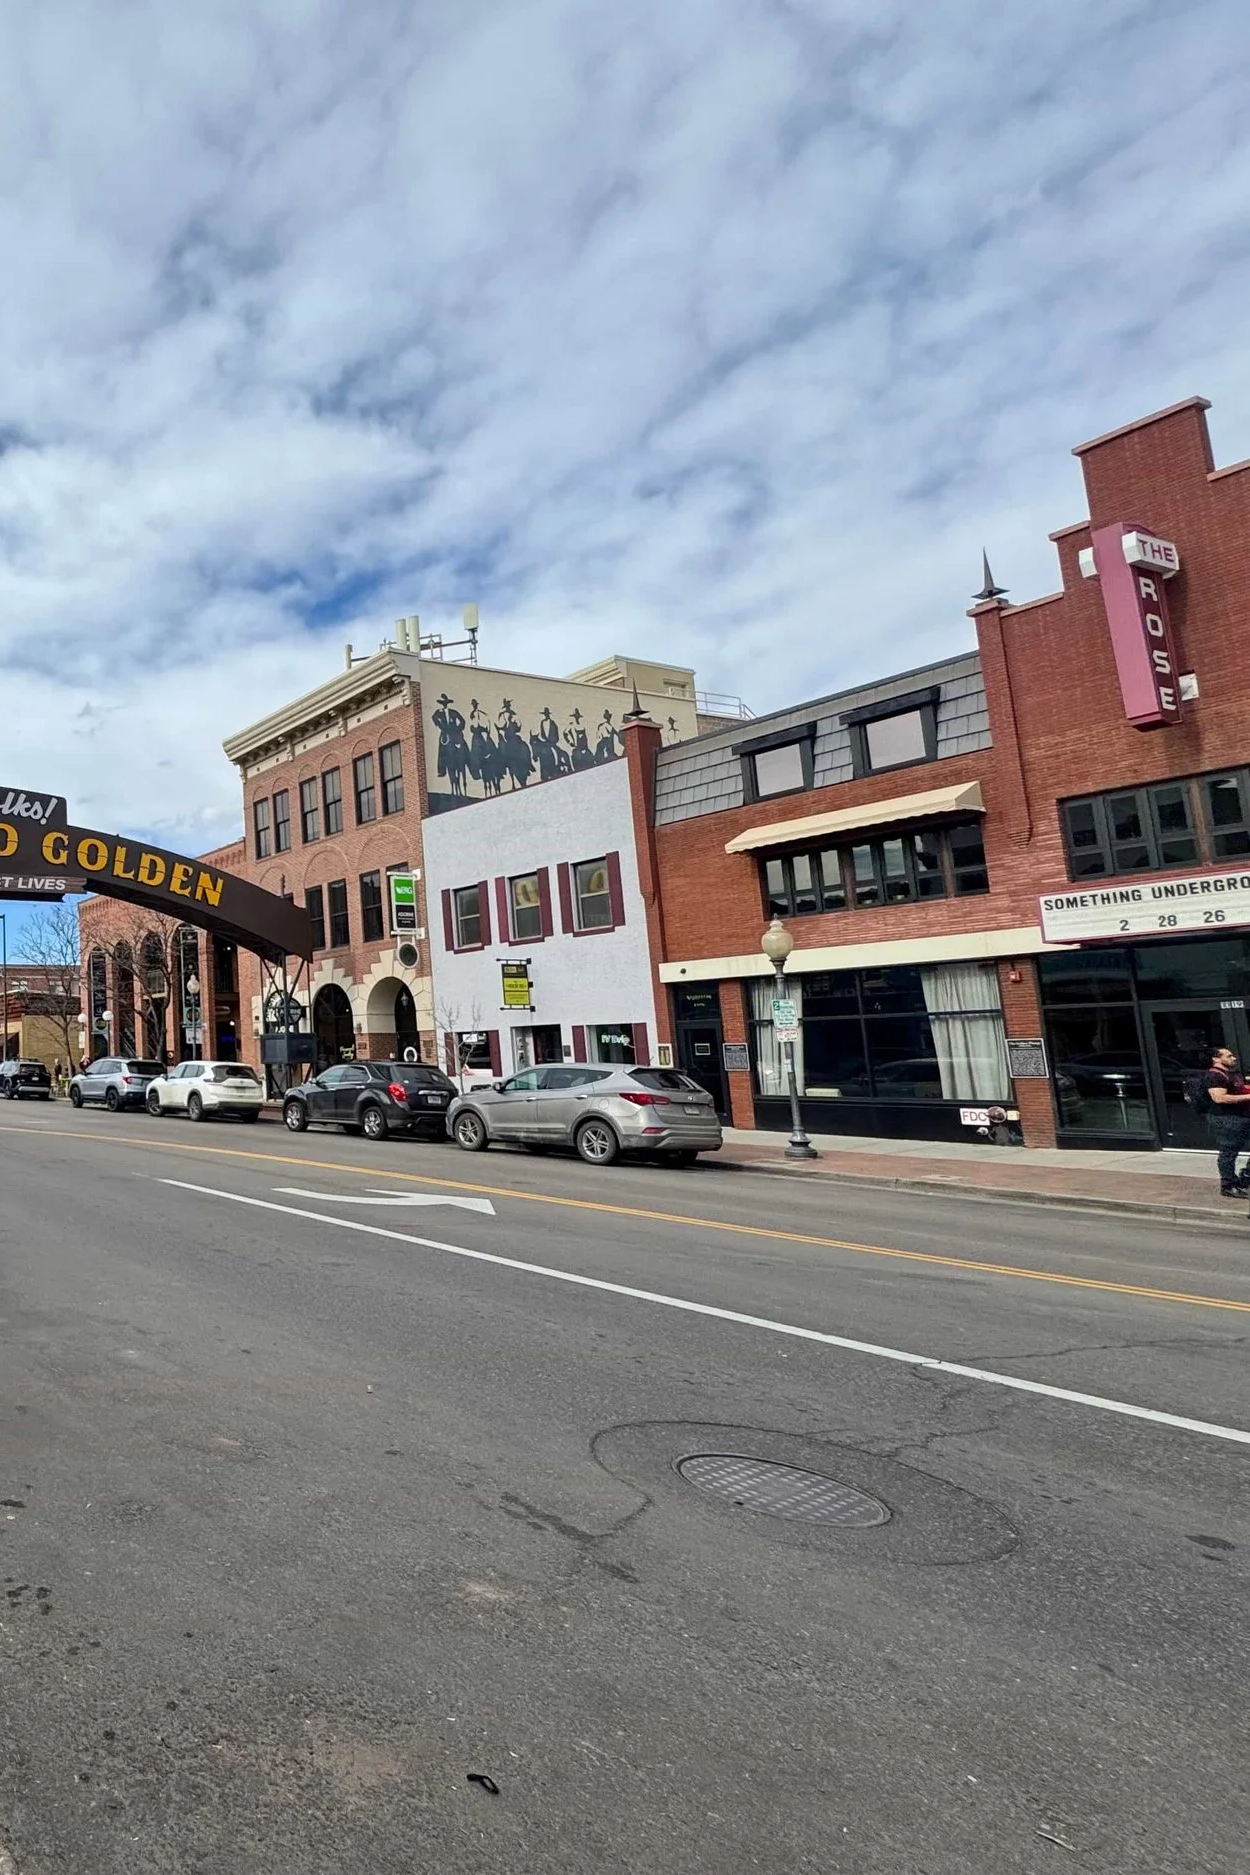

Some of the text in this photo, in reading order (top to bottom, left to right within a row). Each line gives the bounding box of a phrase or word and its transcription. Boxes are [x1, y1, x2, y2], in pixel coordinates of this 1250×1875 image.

[1137, 539, 1175, 562] THE
[1138, 576, 1177, 711] ROSE
[42, 831, 224, 907] GOLDEN
[17, 878, 66, 890] LIVES
[1044, 876, 1250, 911] SOMETHING UNDERGRO
[1119, 910, 1225, 931] 2 28 26
[962, 1111, 987, 1121] FDC
